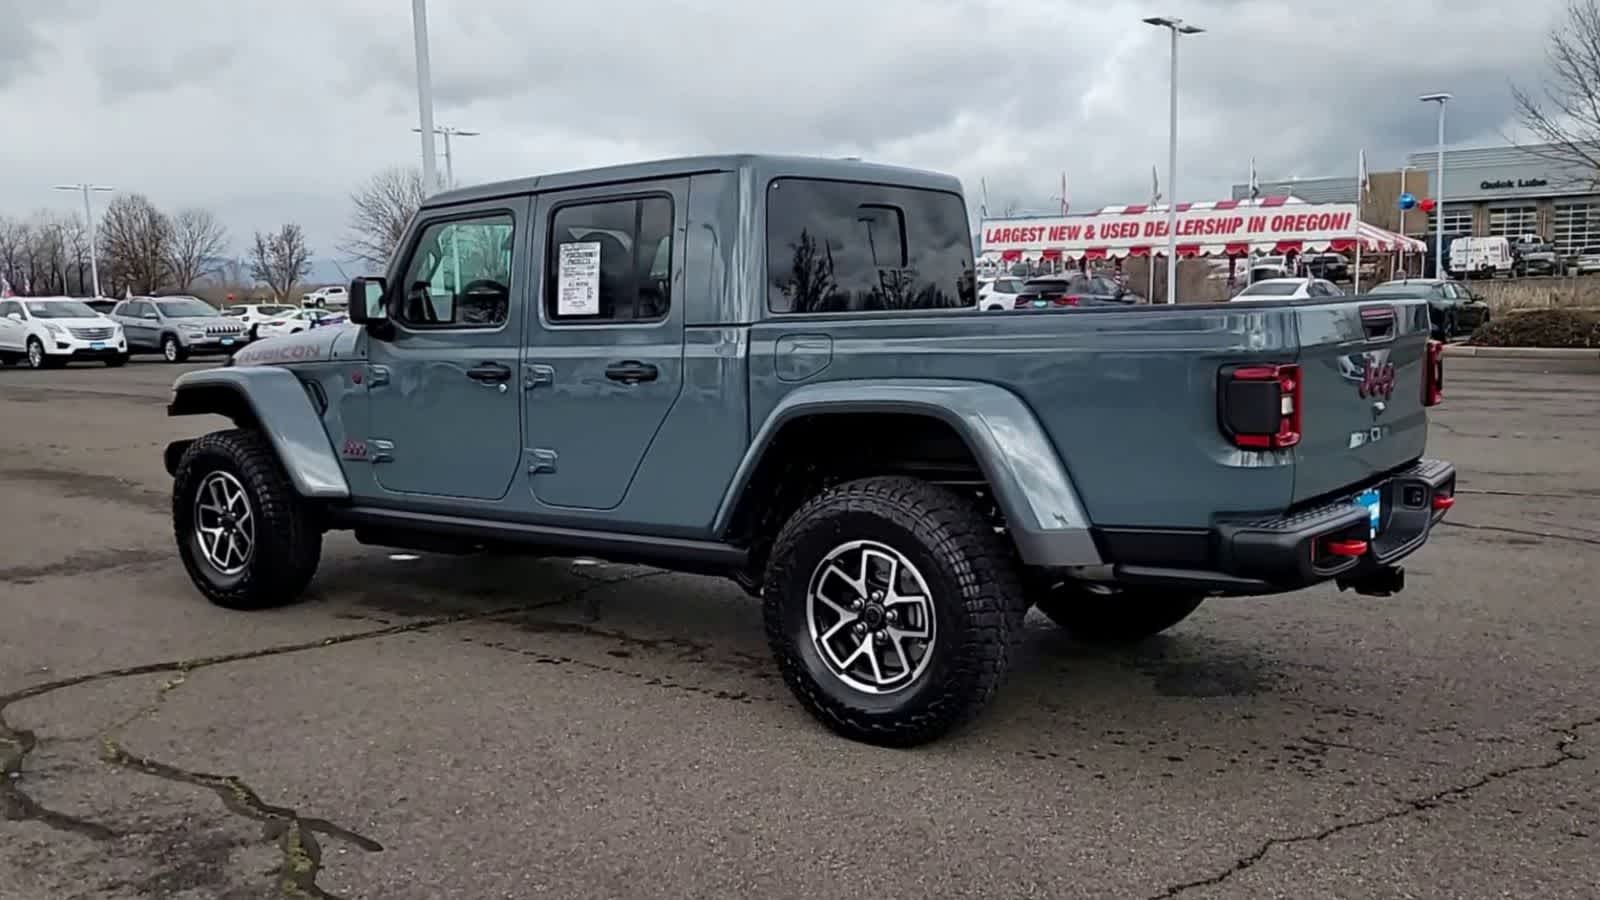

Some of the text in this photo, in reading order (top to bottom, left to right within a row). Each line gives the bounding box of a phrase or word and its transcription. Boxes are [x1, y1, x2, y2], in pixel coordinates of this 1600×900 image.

[1480, 178, 1548, 190] Quick Lube
[986, 226, 1046, 243] LARGEST
[1048, 224, 1081, 241] NEW
[1084, 224, 1095, 240] &
[1100, 222, 1139, 239] USED
[1247, 215, 1267, 233] IN
[1271, 212, 1352, 232] OREGON!
